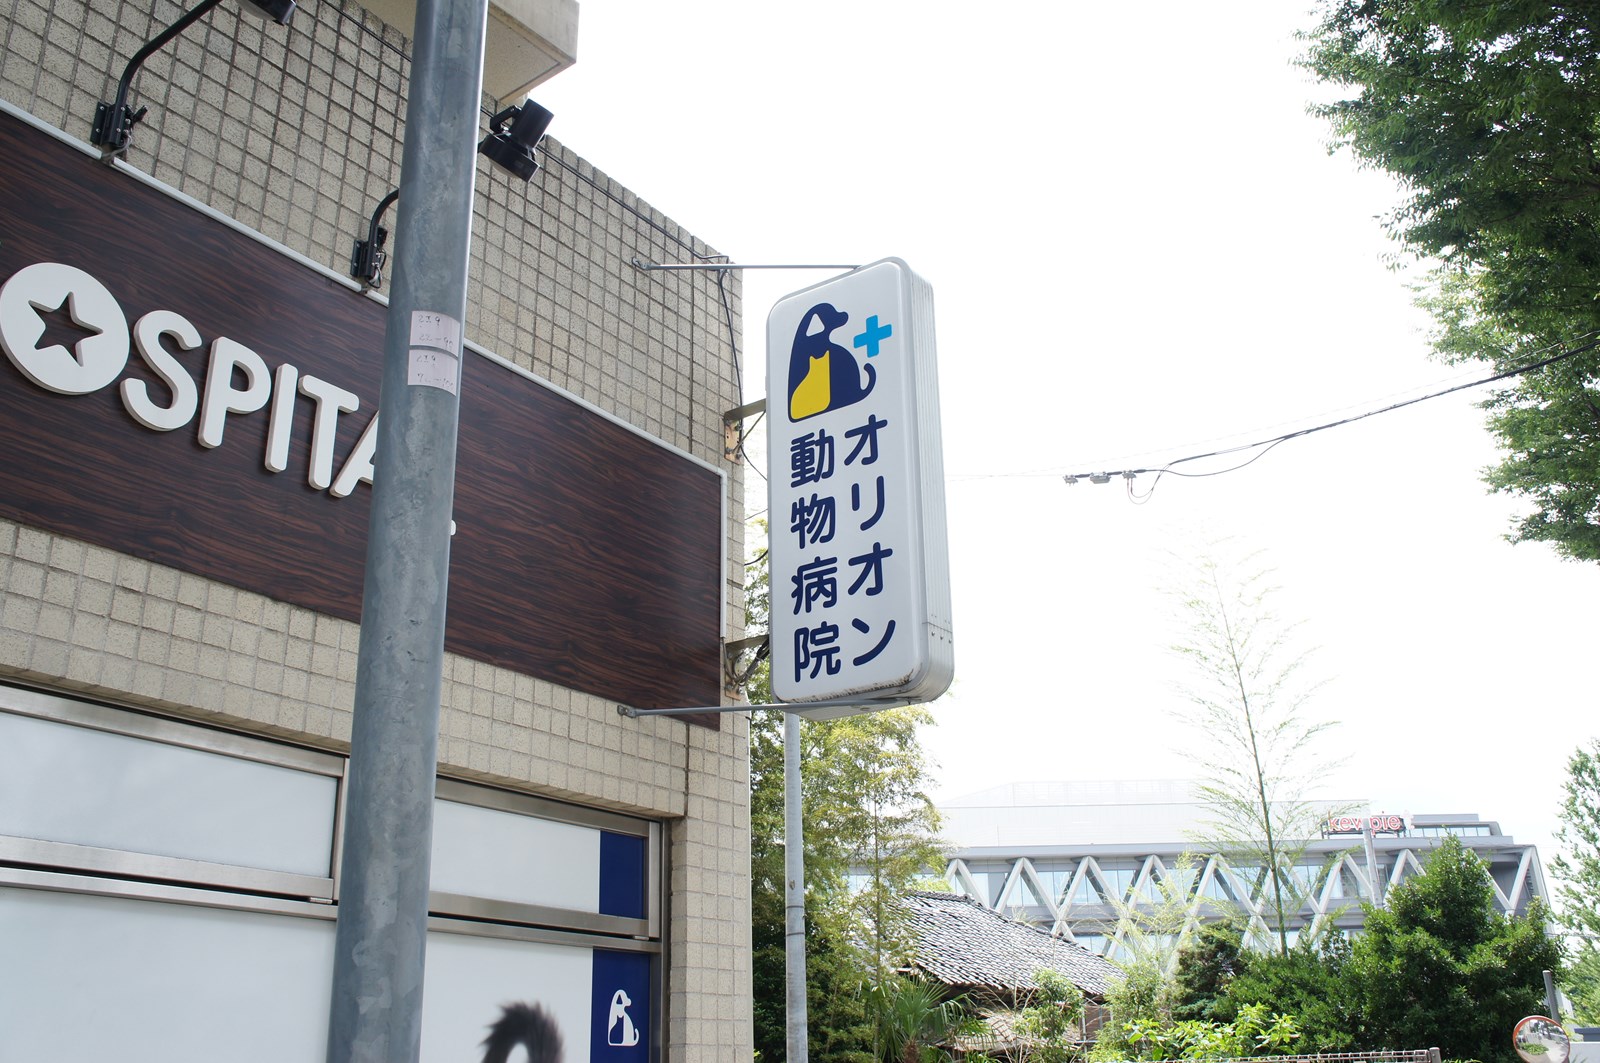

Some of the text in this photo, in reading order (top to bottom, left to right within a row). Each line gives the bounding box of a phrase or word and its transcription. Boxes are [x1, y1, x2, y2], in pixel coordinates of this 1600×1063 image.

[0, 262, 456, 536] OSPITA
[790, 428, 842, 682] 動物病院
[844, 413, 897, 667] オリオン
